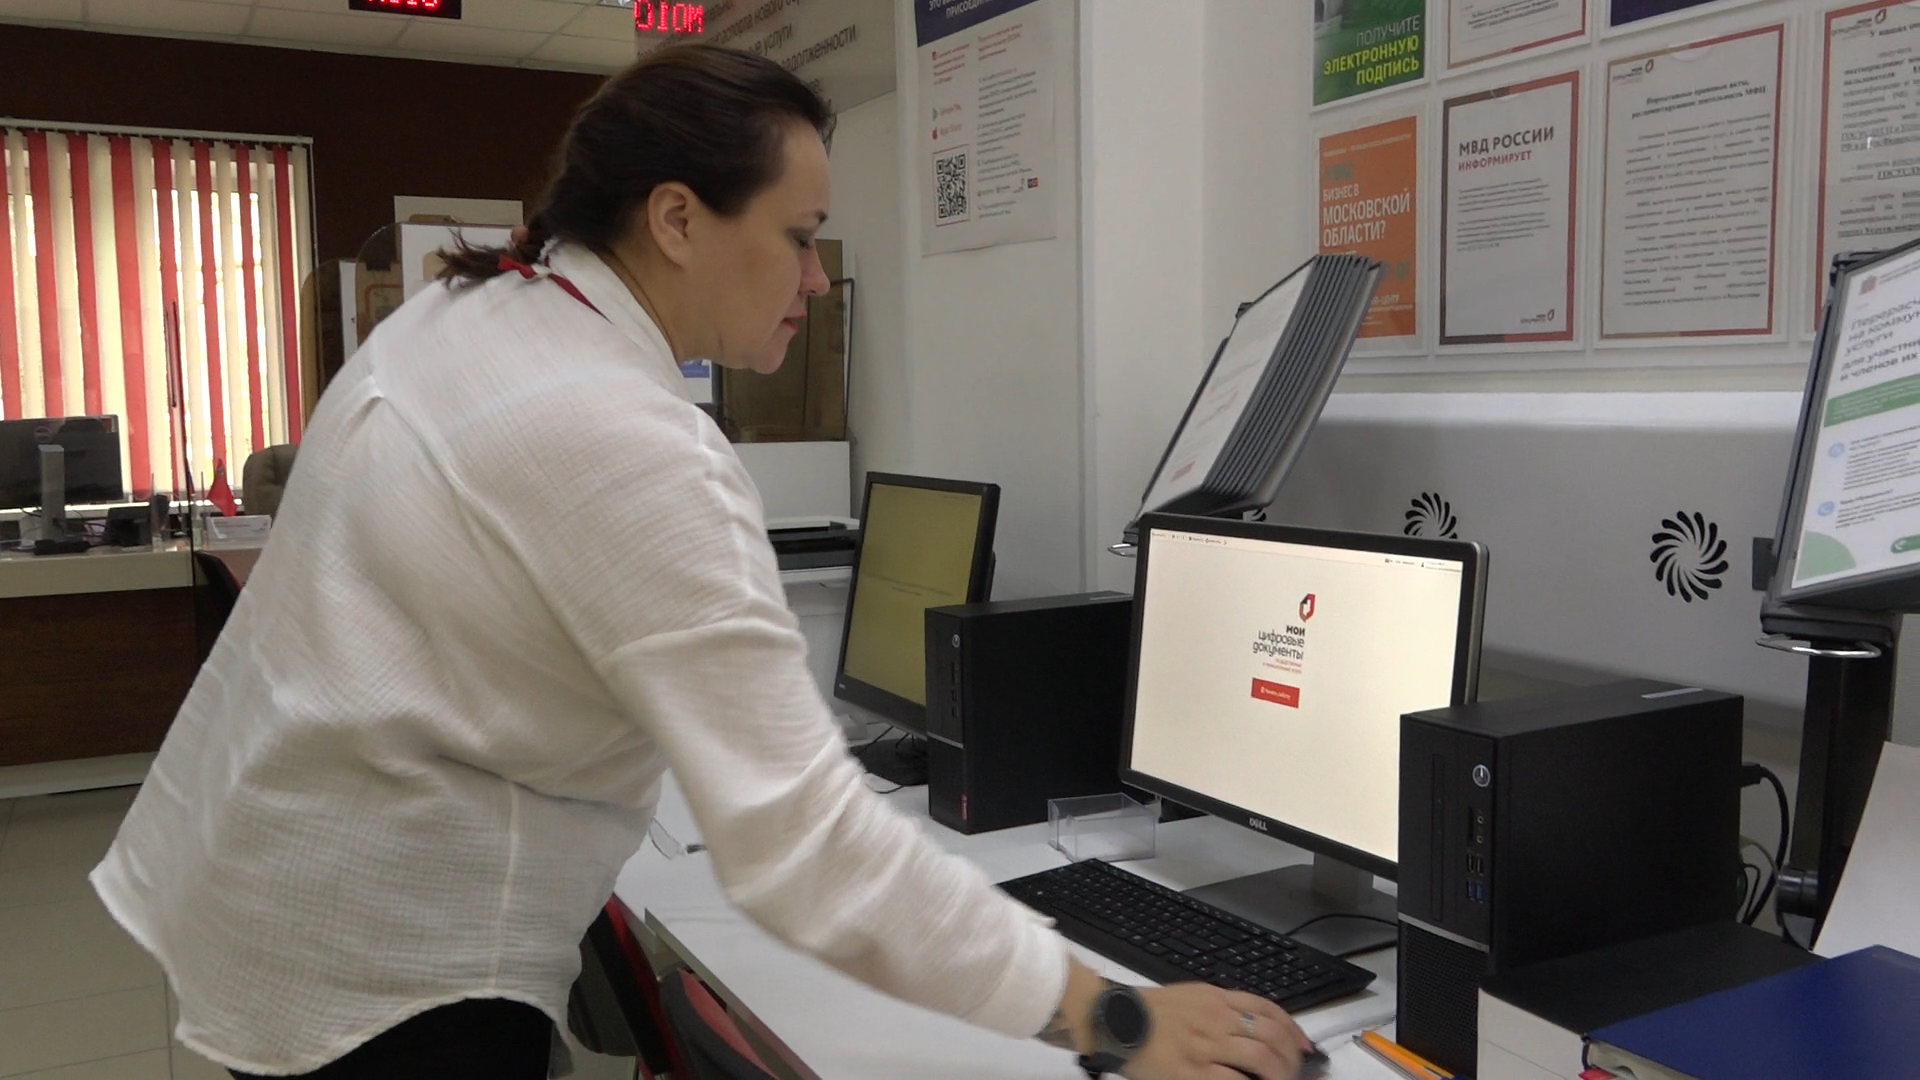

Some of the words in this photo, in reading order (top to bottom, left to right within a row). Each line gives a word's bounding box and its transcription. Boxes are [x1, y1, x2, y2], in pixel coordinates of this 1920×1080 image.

[1356, 14, 1420, 47] ПОЛУЧИТЕ
[1323, 34, 1419, 76] ЭЛЕКТРОННУЮ
[1356, 55, 1420, 86] ПОДПИСЬ
[1459, 138, 1490, 157] МВД
[1493, 125, 1555, 150] РОССИИ
[1458, 150, 1533, 172] ИНФОРМИРУЕТ
[1323, 184, 1353, 202] БИЗНЕС
[1353, 183, 1360, 196] В
[1323, 187, 1411, 225] МОСКОВСКОЙ
[1323, 220, 1387, 247] ОБЛАСТИ?
[1252, 641, 1304, 660] документы
[1258, 630, 1305, 648] цифровые
[1249, 817, 1268, 831] DELL
